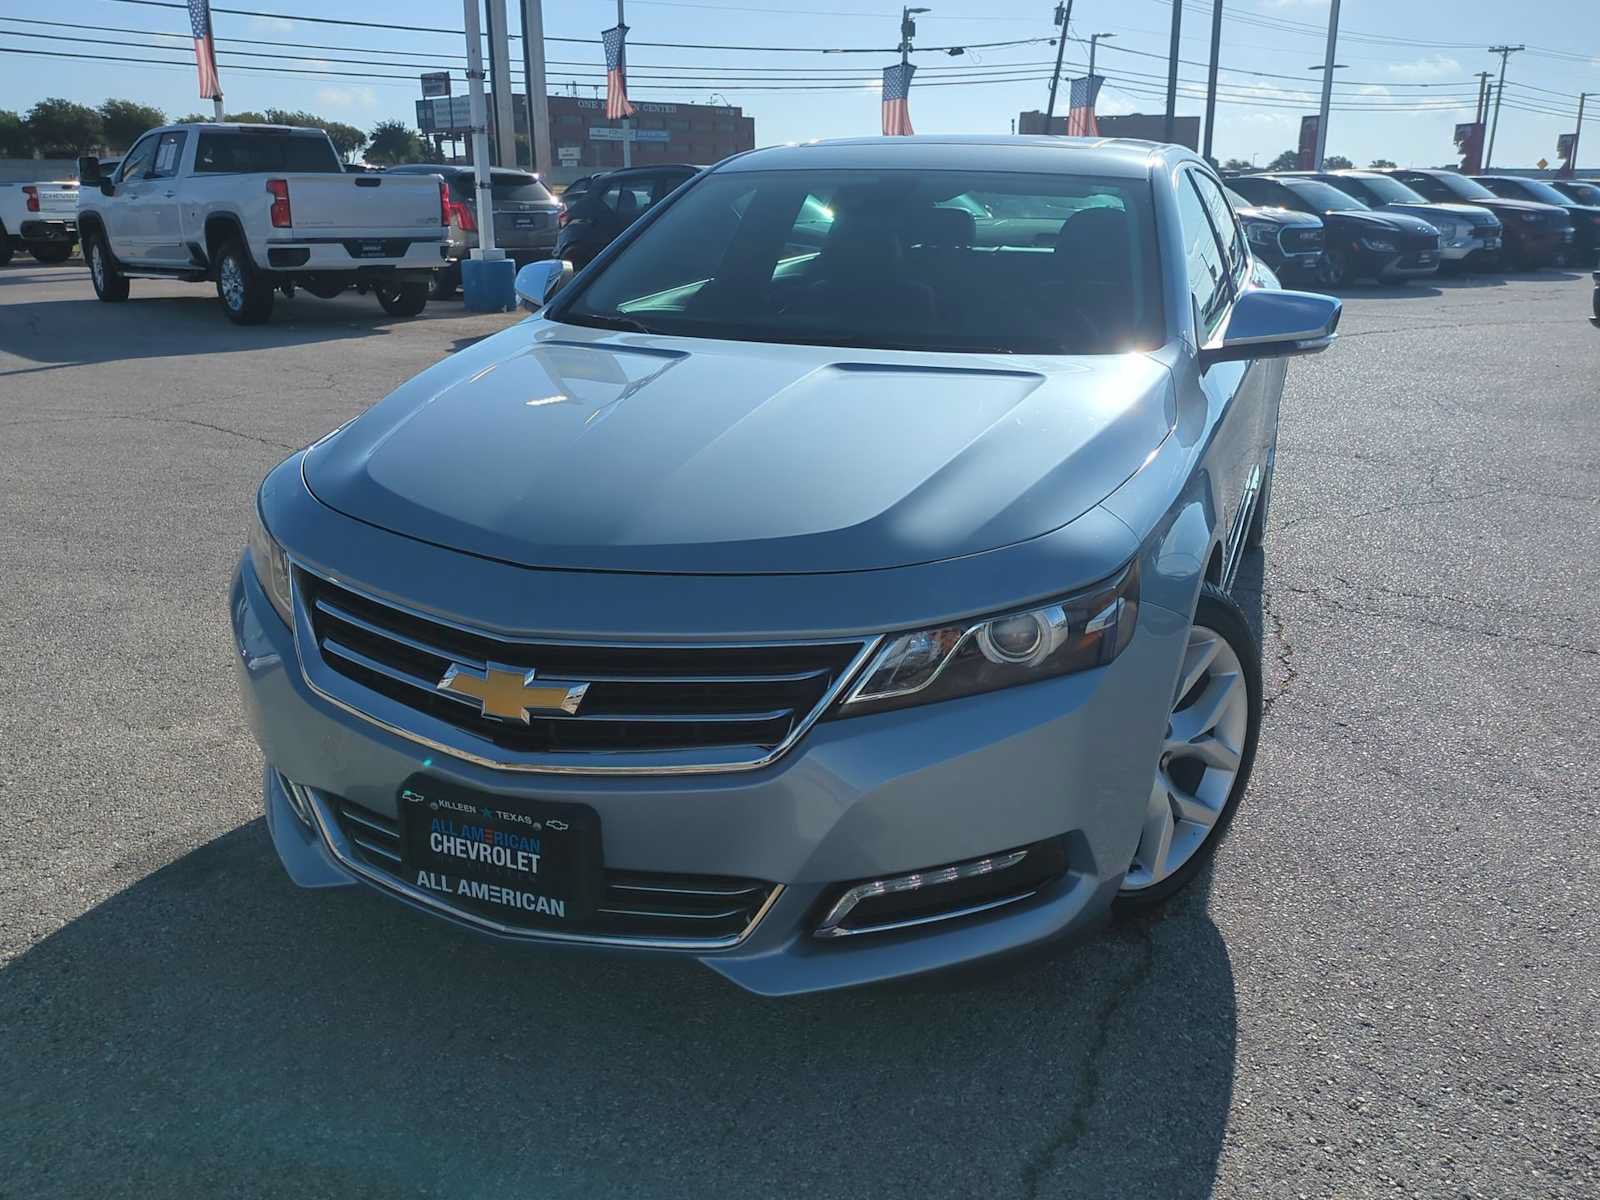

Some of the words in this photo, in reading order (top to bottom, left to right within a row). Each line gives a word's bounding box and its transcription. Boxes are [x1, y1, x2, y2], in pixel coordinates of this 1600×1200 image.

[577, 100, 598, 110] ONE
[643, 103, 677, 113] CENTER
[438, 799, 477, 814] KILLEEN
[495, 810, 533, 825] TEXAS
[430, 832, 541, 874] CHEVROLET
[431, 817, 454, 834] ALL
[462, 825, 541, 853] AMERICAN
[416, 870, 453, 893] ALL
[457, 879, 566, 918] AMERICAN
